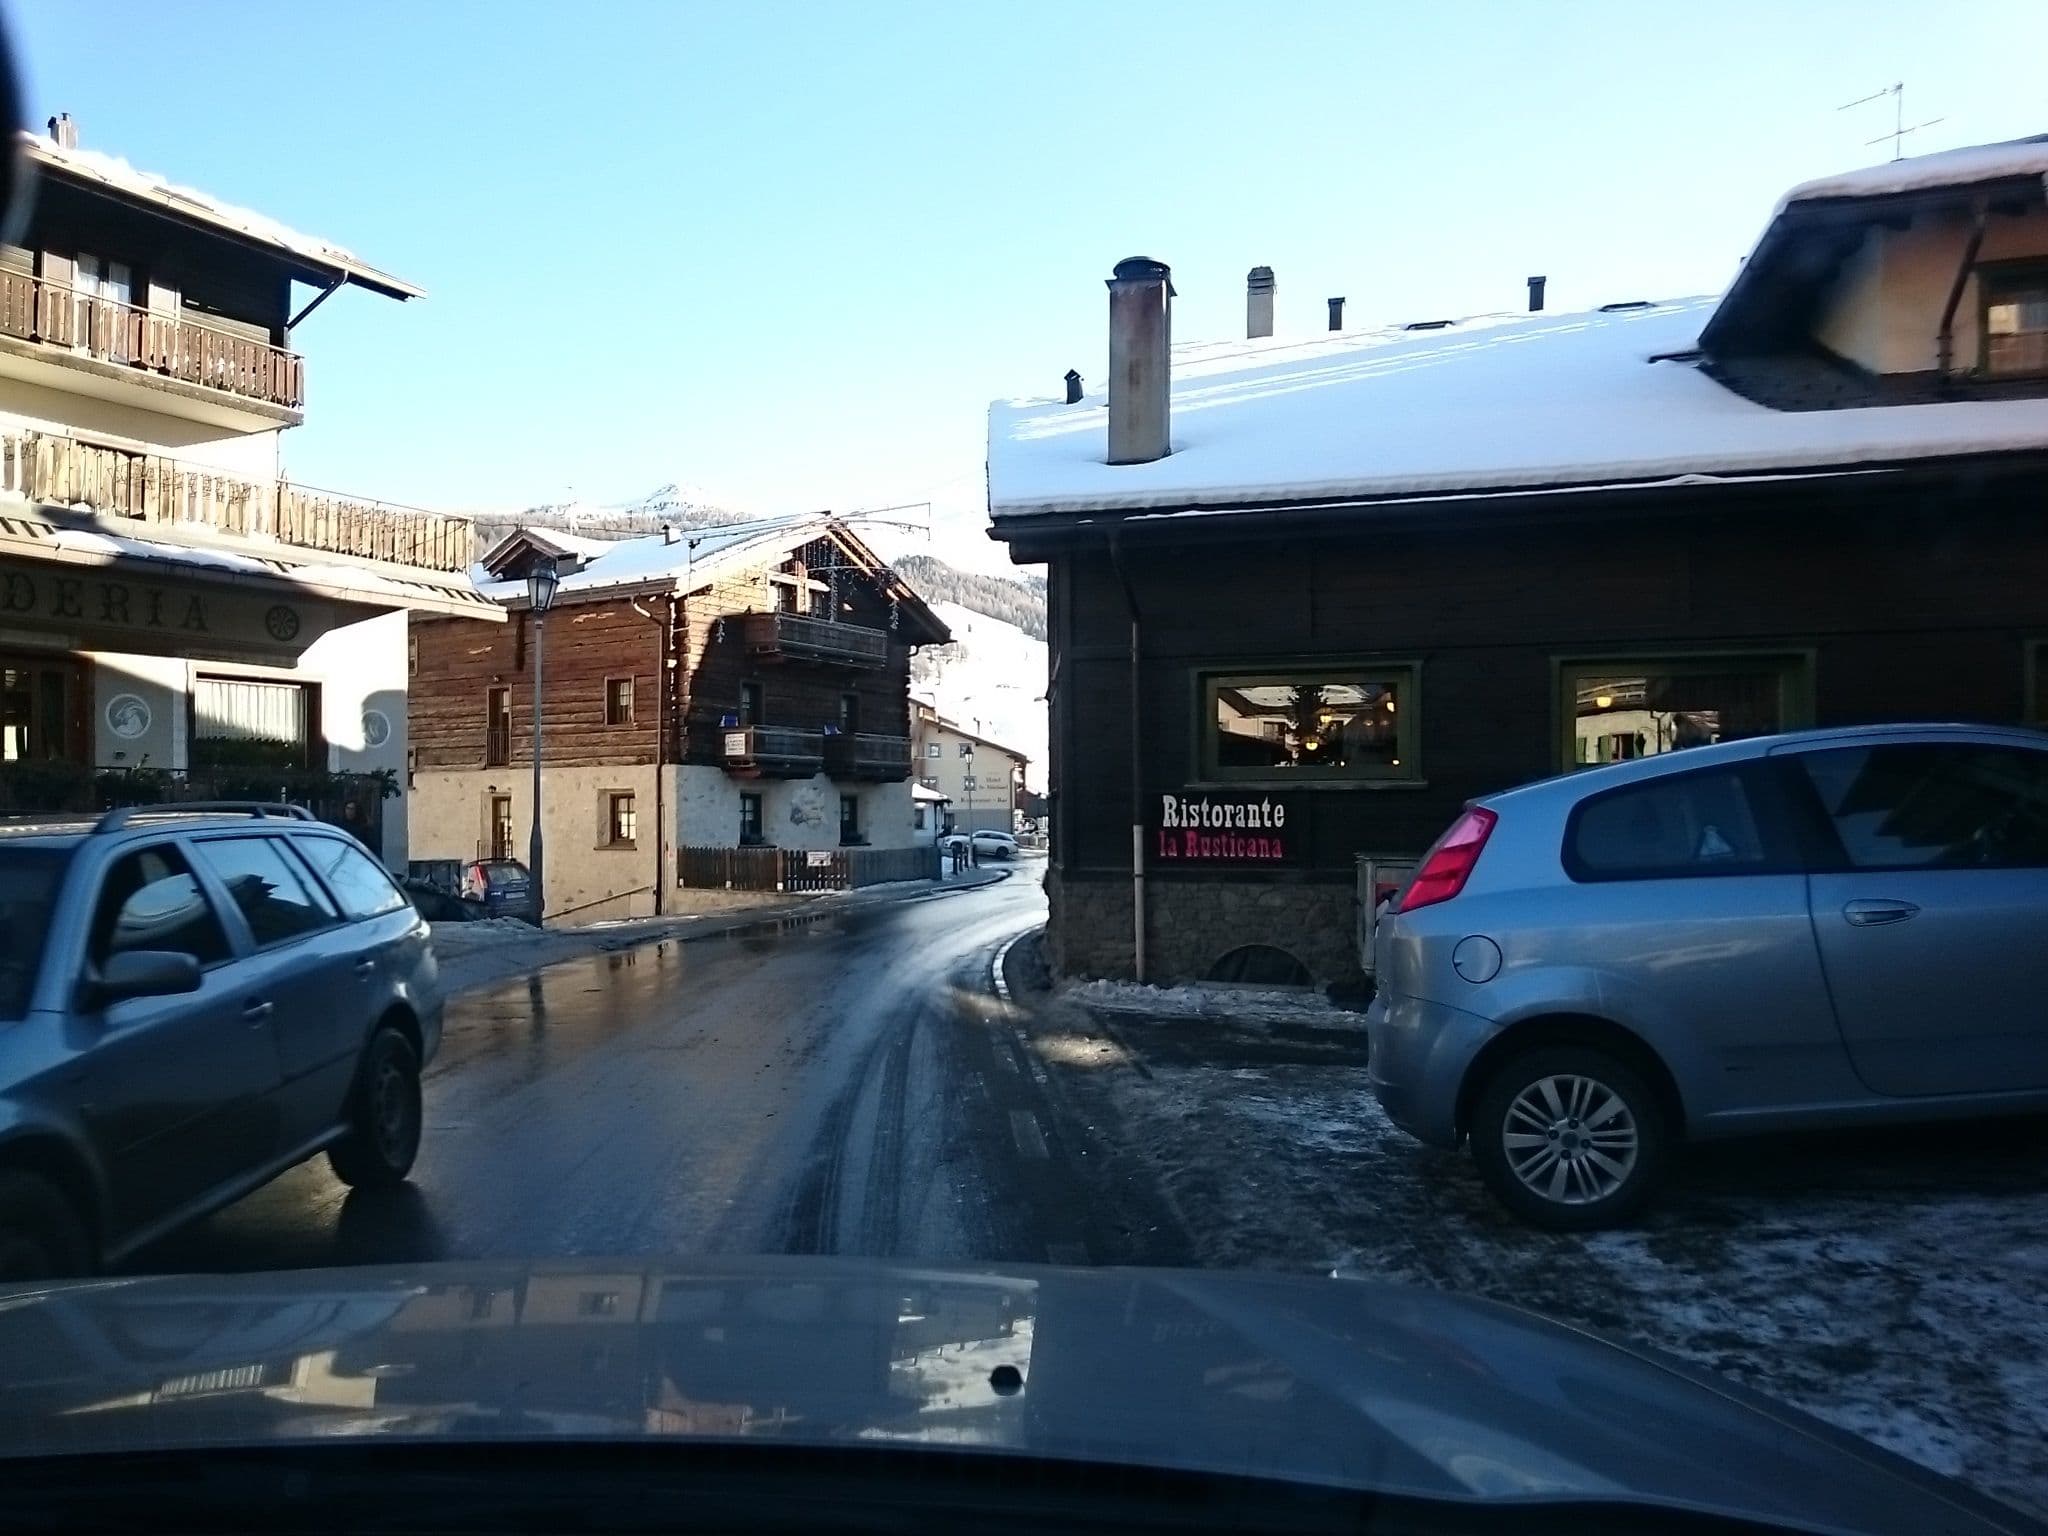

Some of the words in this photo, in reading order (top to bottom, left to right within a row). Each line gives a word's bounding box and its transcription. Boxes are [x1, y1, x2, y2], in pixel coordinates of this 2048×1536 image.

[2, 571, 209, 631] DERIA
[1162, 794, 1285, 828] Ristorante
[1159, 830, 1178, 857] la
[1185, 830, 1283, 858] Rusticana
